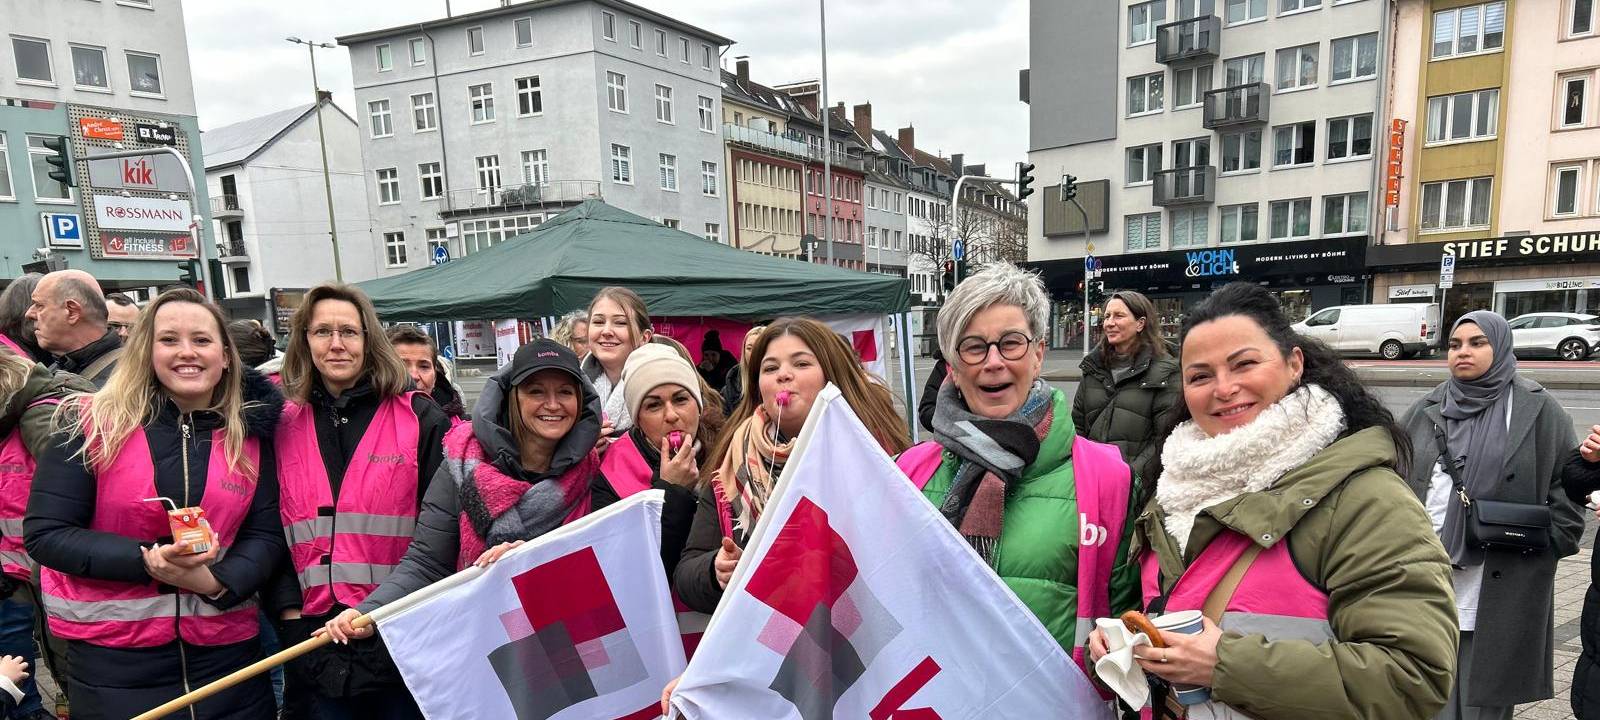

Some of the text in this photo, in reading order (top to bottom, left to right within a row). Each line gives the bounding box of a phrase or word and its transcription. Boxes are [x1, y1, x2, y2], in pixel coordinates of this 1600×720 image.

[125, 156, 153, 185] kik
[1393, 121, 1403, 203] SCHUHE
[106, 207, 183, 220] ROSSMANN
[58, 218, 74, 235] P
[124, 244, 164, 252] FITNESS
[1186, 249, 1234, 263] WOHN
[1443, 240, 1508, 258] STIEF
